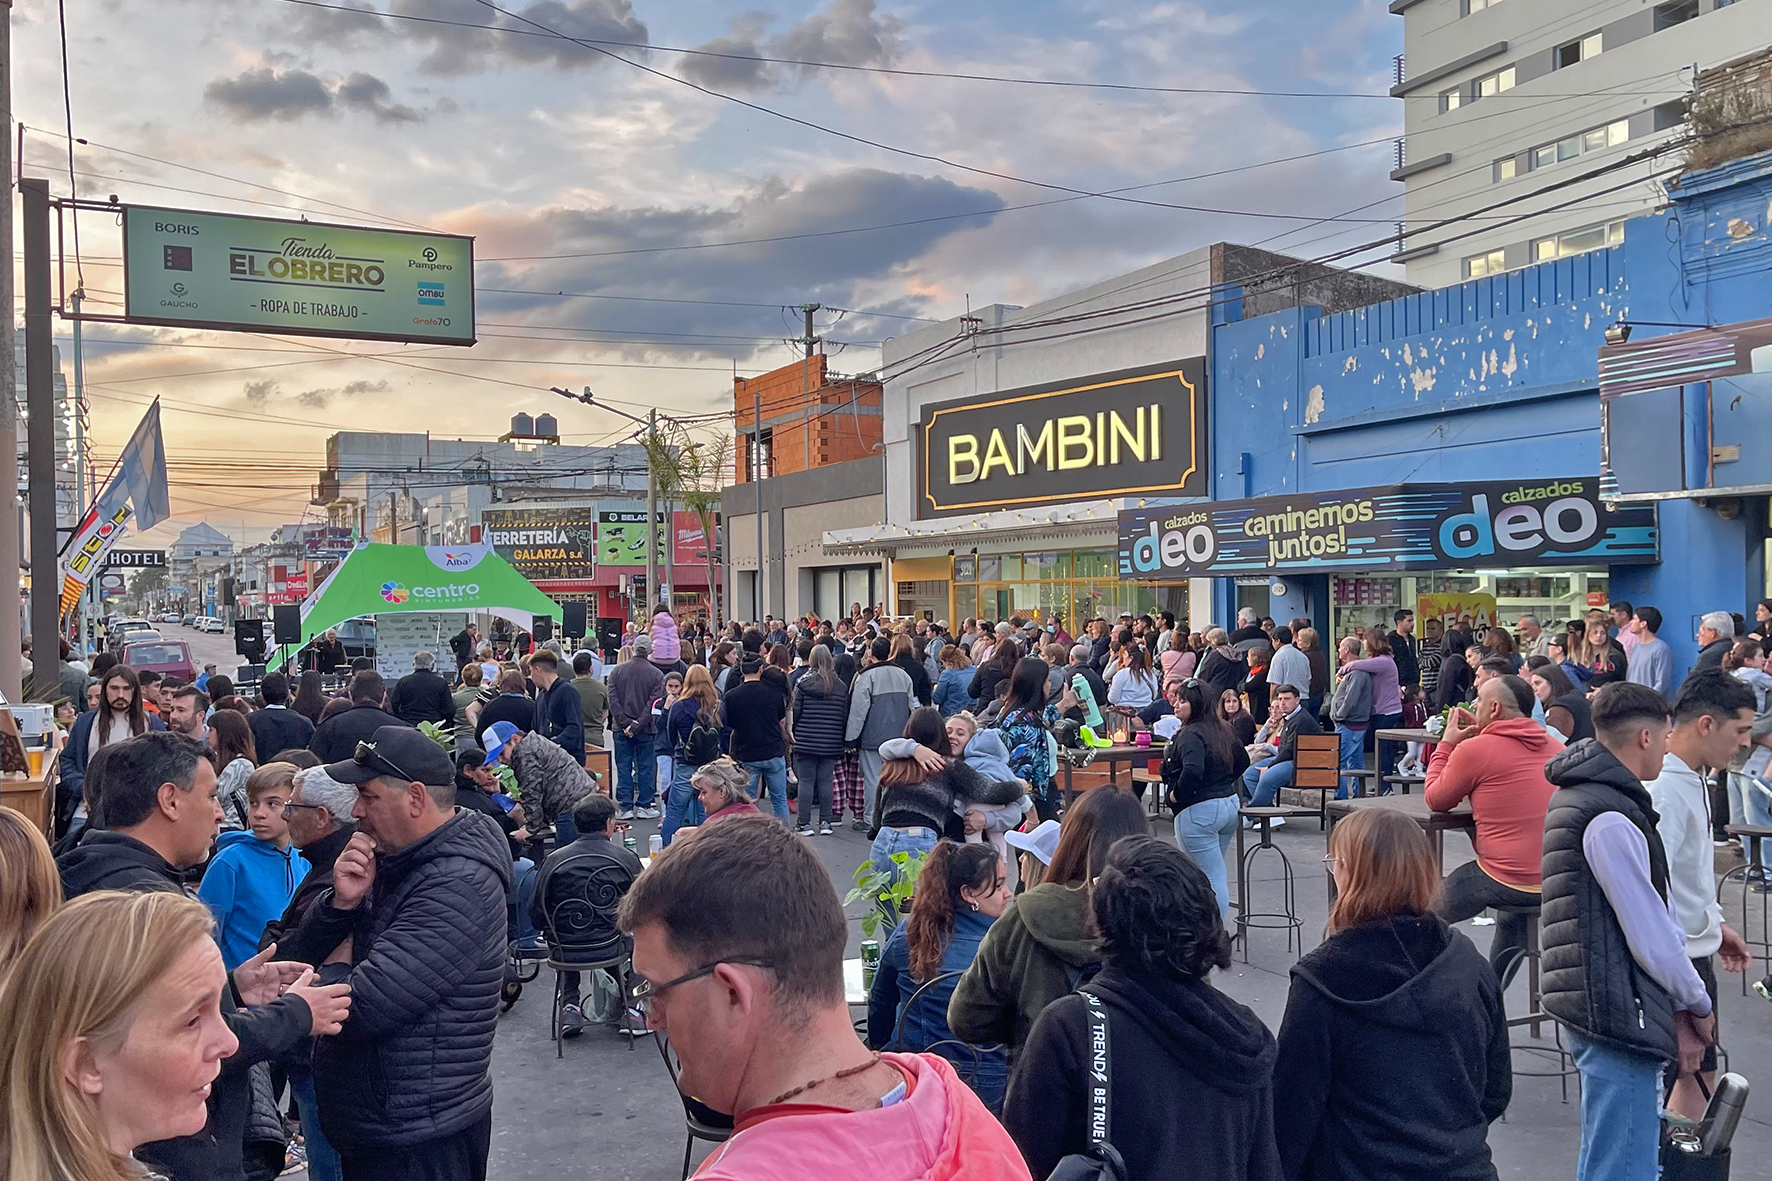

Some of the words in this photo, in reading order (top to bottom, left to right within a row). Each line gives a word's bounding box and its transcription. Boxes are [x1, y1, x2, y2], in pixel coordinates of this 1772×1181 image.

[155, 222, 199, 235] BORIS
[281, 237, 336, 260] Tienda
[408, 259, 453, 271] Pampero
[160, 300, 198, 309] GAUCHO
[260, 299, 290, 314] ROPA
[293, 302, 307, 315] DE
[310, 303, 358, 318] TRABAJO
[948, 403, 1161, 485] BAMBINI
[1501, 481, 1584, 504] calzados
[1164, 511, 1207, 529] calzados
[1243, 500, 1373, 537] caminemos
[1439, 493, 1598, 559] deo
[491, 526, 569, 546] ERRETERÍA
[513, 548, 567, 560] GALARZA
[1133, 520, 1214, 573] deo
[1267, 525, 1346, 567] juntos!
[110, 552, 163, 565] HOTEL
[446, 558, 468, 566] Alba
[412, 583, 480, 598] centro
[415, 595, 480, 603] PINTURERIAS
